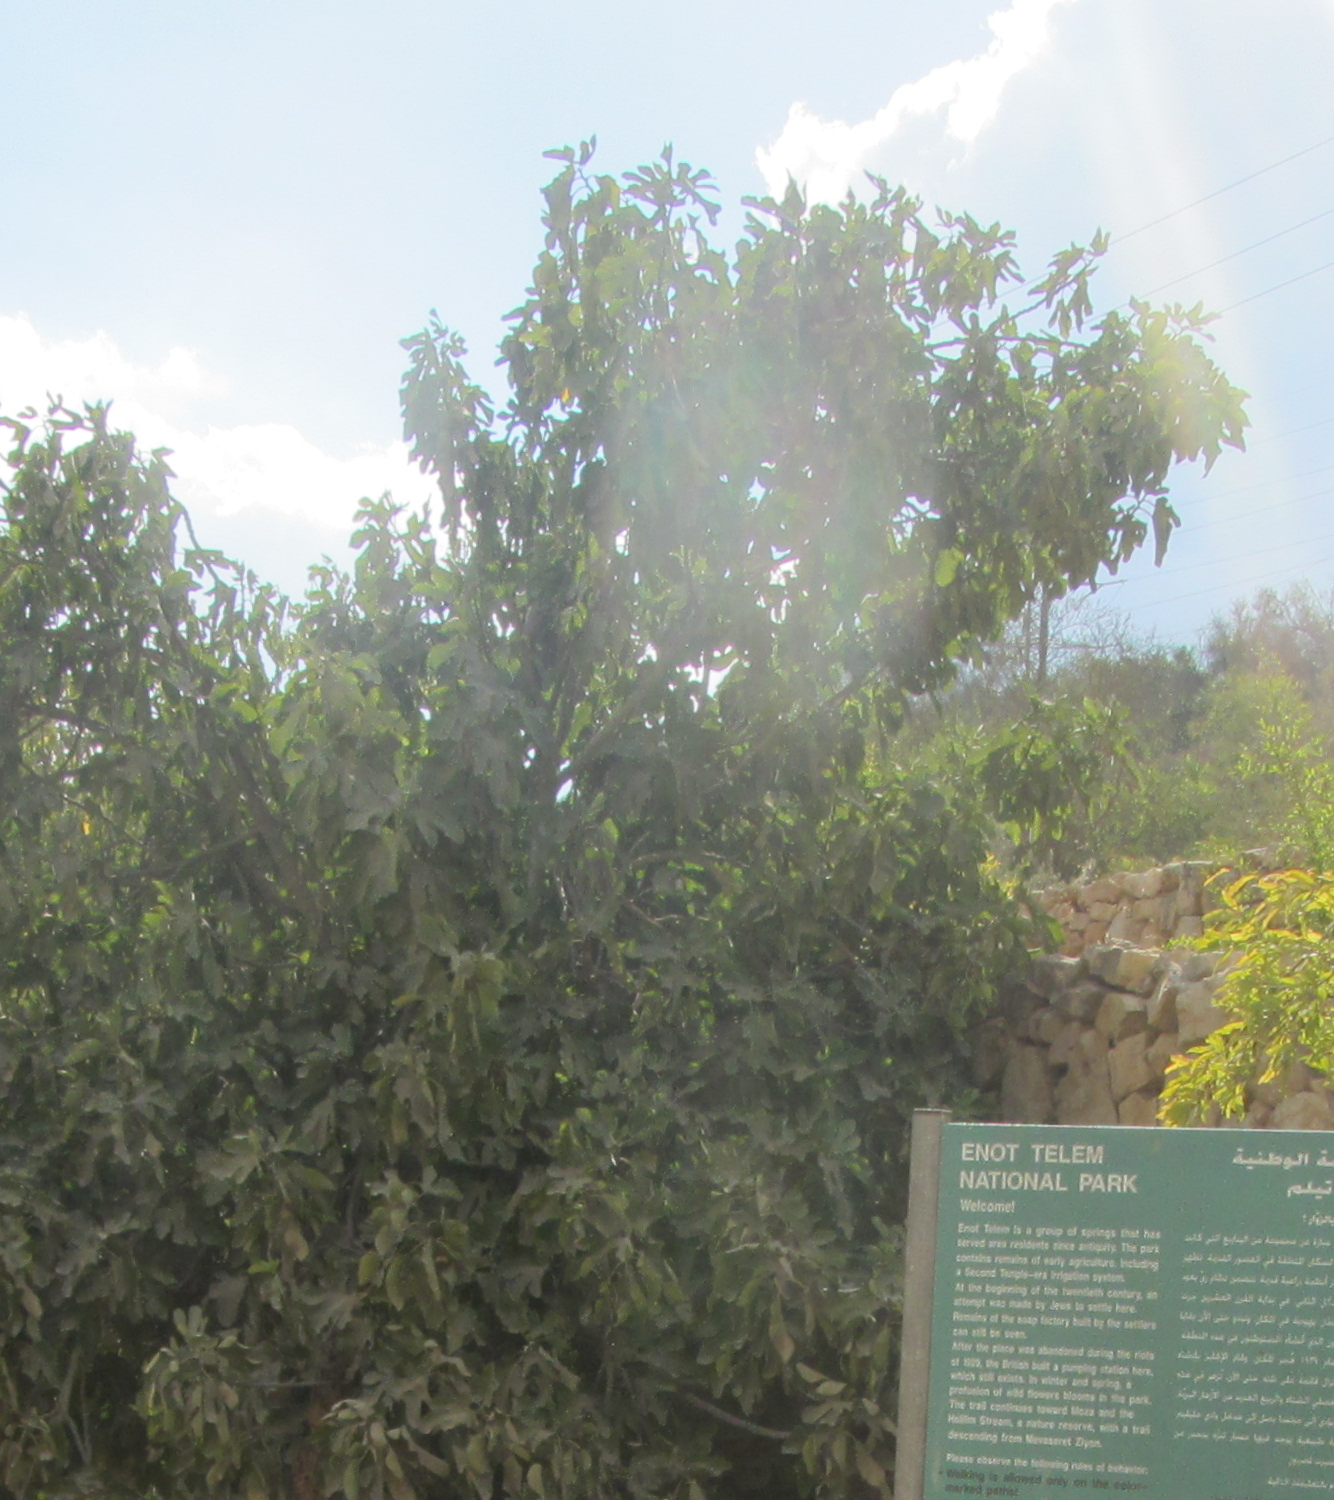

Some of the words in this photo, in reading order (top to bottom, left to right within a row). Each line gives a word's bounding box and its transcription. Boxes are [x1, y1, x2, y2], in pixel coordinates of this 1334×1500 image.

[961, 1142, 1018, 1161] ENOT
[1031, 1144, 1103, 1163] TELEM
[1232, 1147, 1309, 1170] الوطنية
[959, 1170, 1067, 1191] NATIONAL
[1079, 1173, 1137, 1192] PARK
[1286, 1179, 1332, 1199] تيلم
[959, 1199, 1015, 1213] Welcome!
